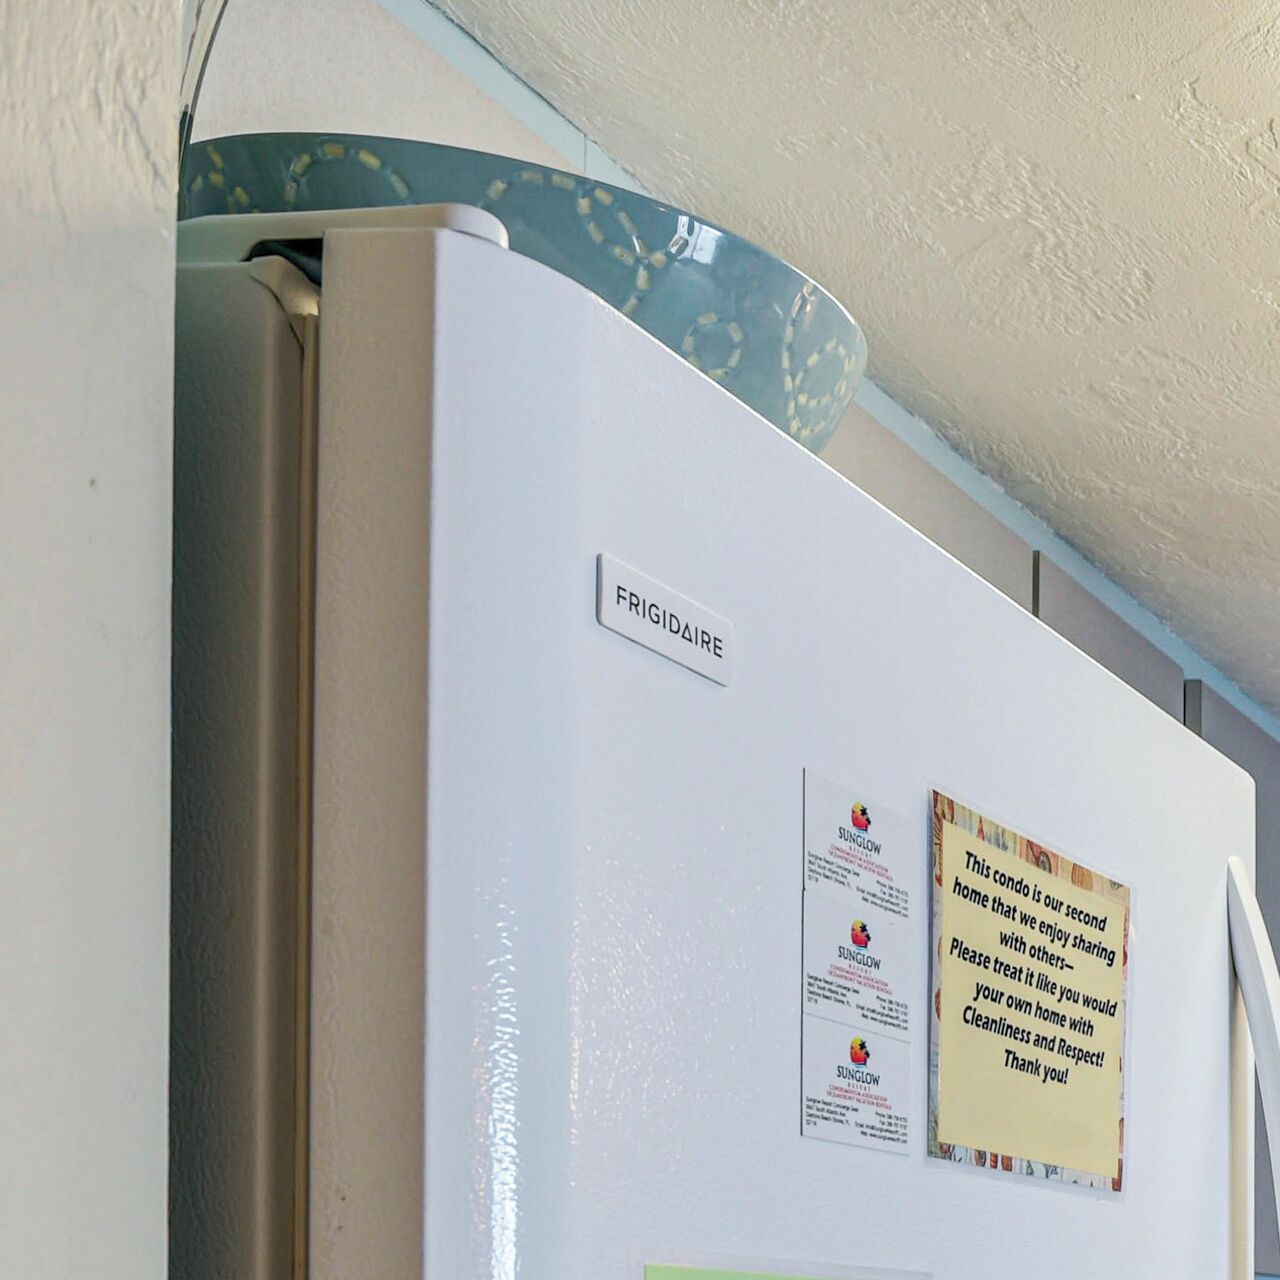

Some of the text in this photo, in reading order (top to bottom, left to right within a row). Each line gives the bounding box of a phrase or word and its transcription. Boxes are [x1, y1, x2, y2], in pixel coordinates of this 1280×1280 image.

[616, 584, 724, 659] FRIGIDAIRE
[838, 826, 882, 855] SUNGLOW
[964, 851, 1108, 933] This condo is our second
[952, 876, 1116, 968] home that we enjoy sharing
[999, 932, 1027, 956] with
[838, 945, 881, 970] SUNGLOW
[949, 937, 1118, 1019] Please treat it like you would
[962, 1006, 1105, 1068] Cleanliness and Respect!
[972, 982, 1095, 1038] your own home with
[836, 1065, 881, 1087] SUNGLOW
[1003, 1049, 1070, 1085] Thank you!
